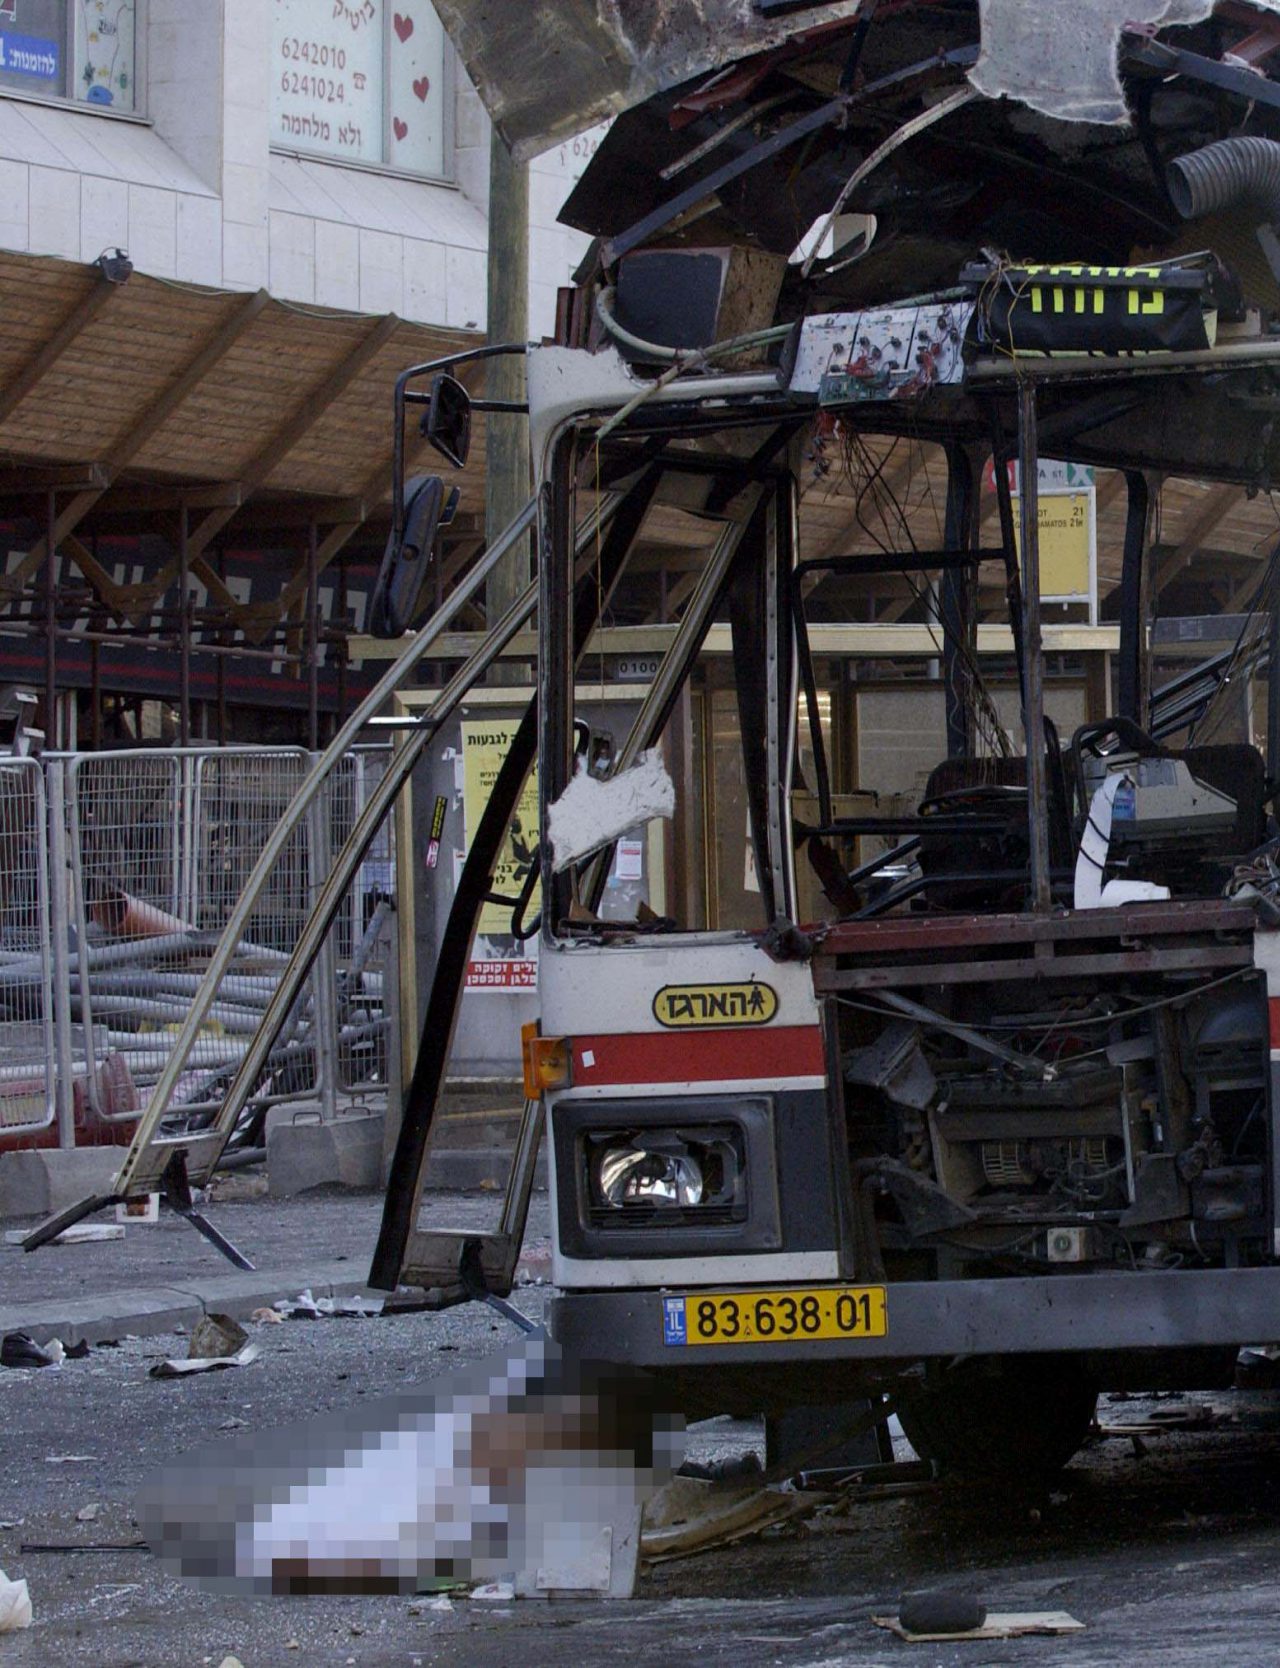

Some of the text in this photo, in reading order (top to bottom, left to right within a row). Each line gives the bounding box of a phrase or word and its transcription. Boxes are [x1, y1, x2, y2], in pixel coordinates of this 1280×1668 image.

[282, 37, 346, 70] 6242010
[281, 70, 344, 103] 6241024
[281, 112, 361, 146] ולא מלחמה
[1072, 506, 1084, 516] 21
[468, 732, 508, 746] לגבעות
[666, 992, 747, 1018] הארגז
[670, 1312, 683, 1331] IL
